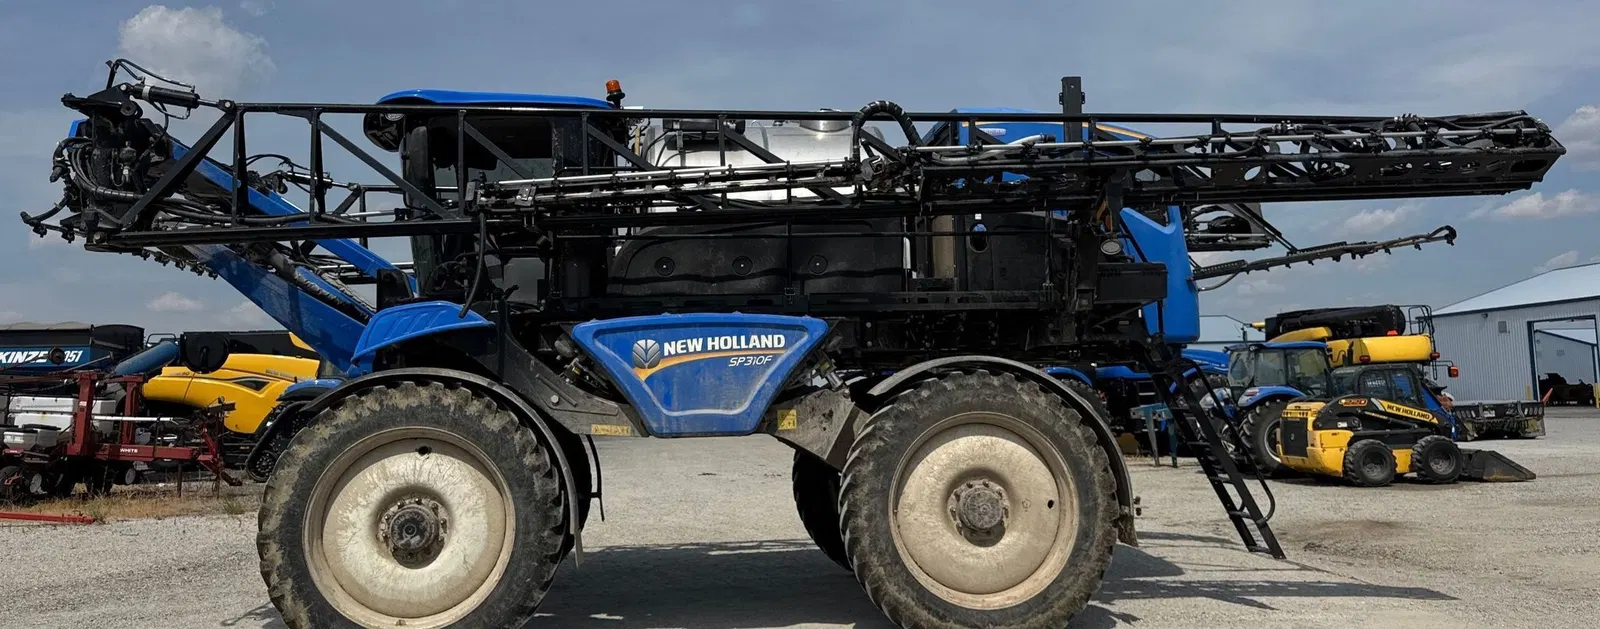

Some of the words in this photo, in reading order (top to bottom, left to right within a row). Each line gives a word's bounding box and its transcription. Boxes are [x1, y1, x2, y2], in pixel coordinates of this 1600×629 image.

[663, 337, 704, 356] NEW
[707, 334, 785, 351] HOLLAND
[728, 355, 772, 367] SP310F
[1387, 404, 1401, 412] NEW
[1402, 408, 1430, 419] HOLLAND
